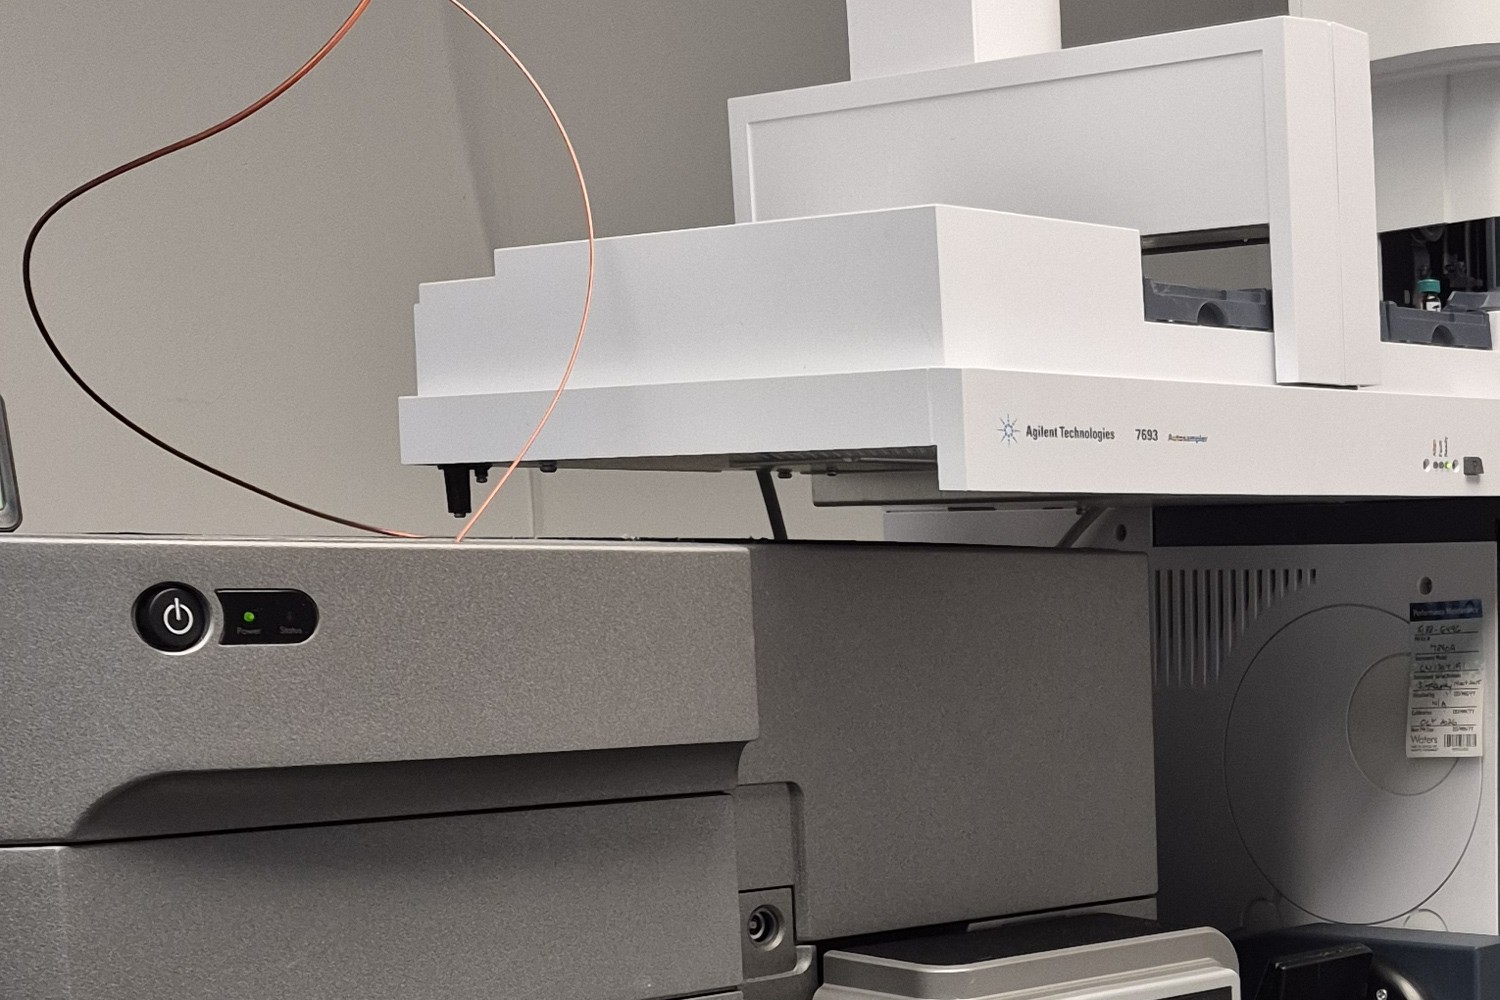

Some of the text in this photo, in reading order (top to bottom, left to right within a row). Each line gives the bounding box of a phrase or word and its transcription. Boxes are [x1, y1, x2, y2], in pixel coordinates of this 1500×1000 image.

[1026, 425, 1115, 442] Agilent Technologies
[1135, 428, 1159, 441] 7693
[1410, 735, 1438, 744] Waters
